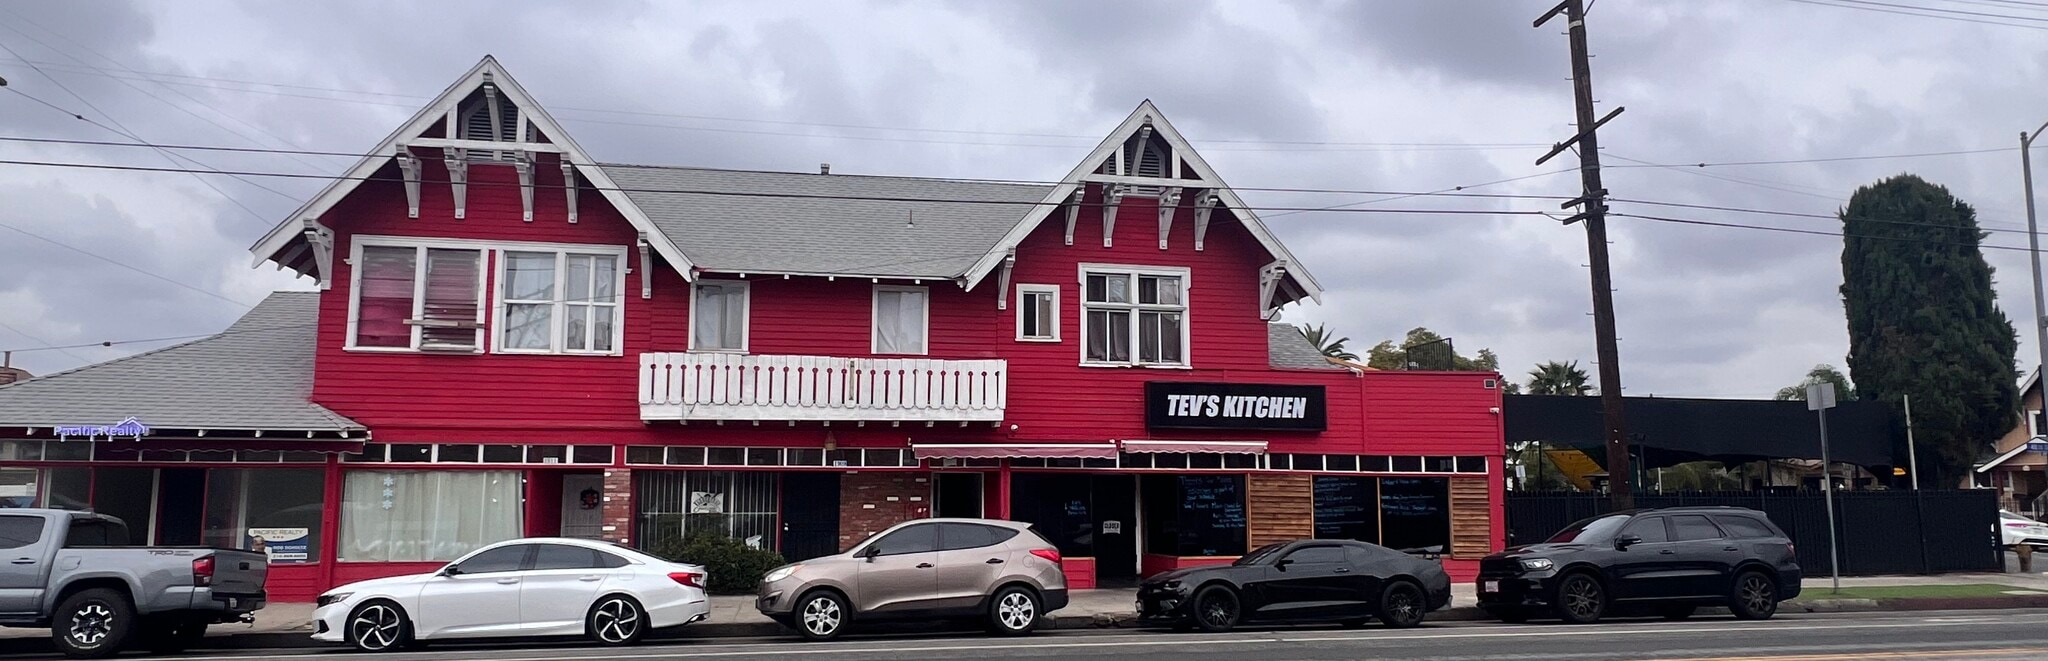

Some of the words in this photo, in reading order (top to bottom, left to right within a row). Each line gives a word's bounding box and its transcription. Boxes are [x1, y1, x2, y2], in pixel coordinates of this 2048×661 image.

[1167, 394, 1220, 417] TEV'S
[1222, 395, 1307, 418] KITCHEN
[53, 426, 98, 436] Pacific
[100, 425, 142, 438] Realty
